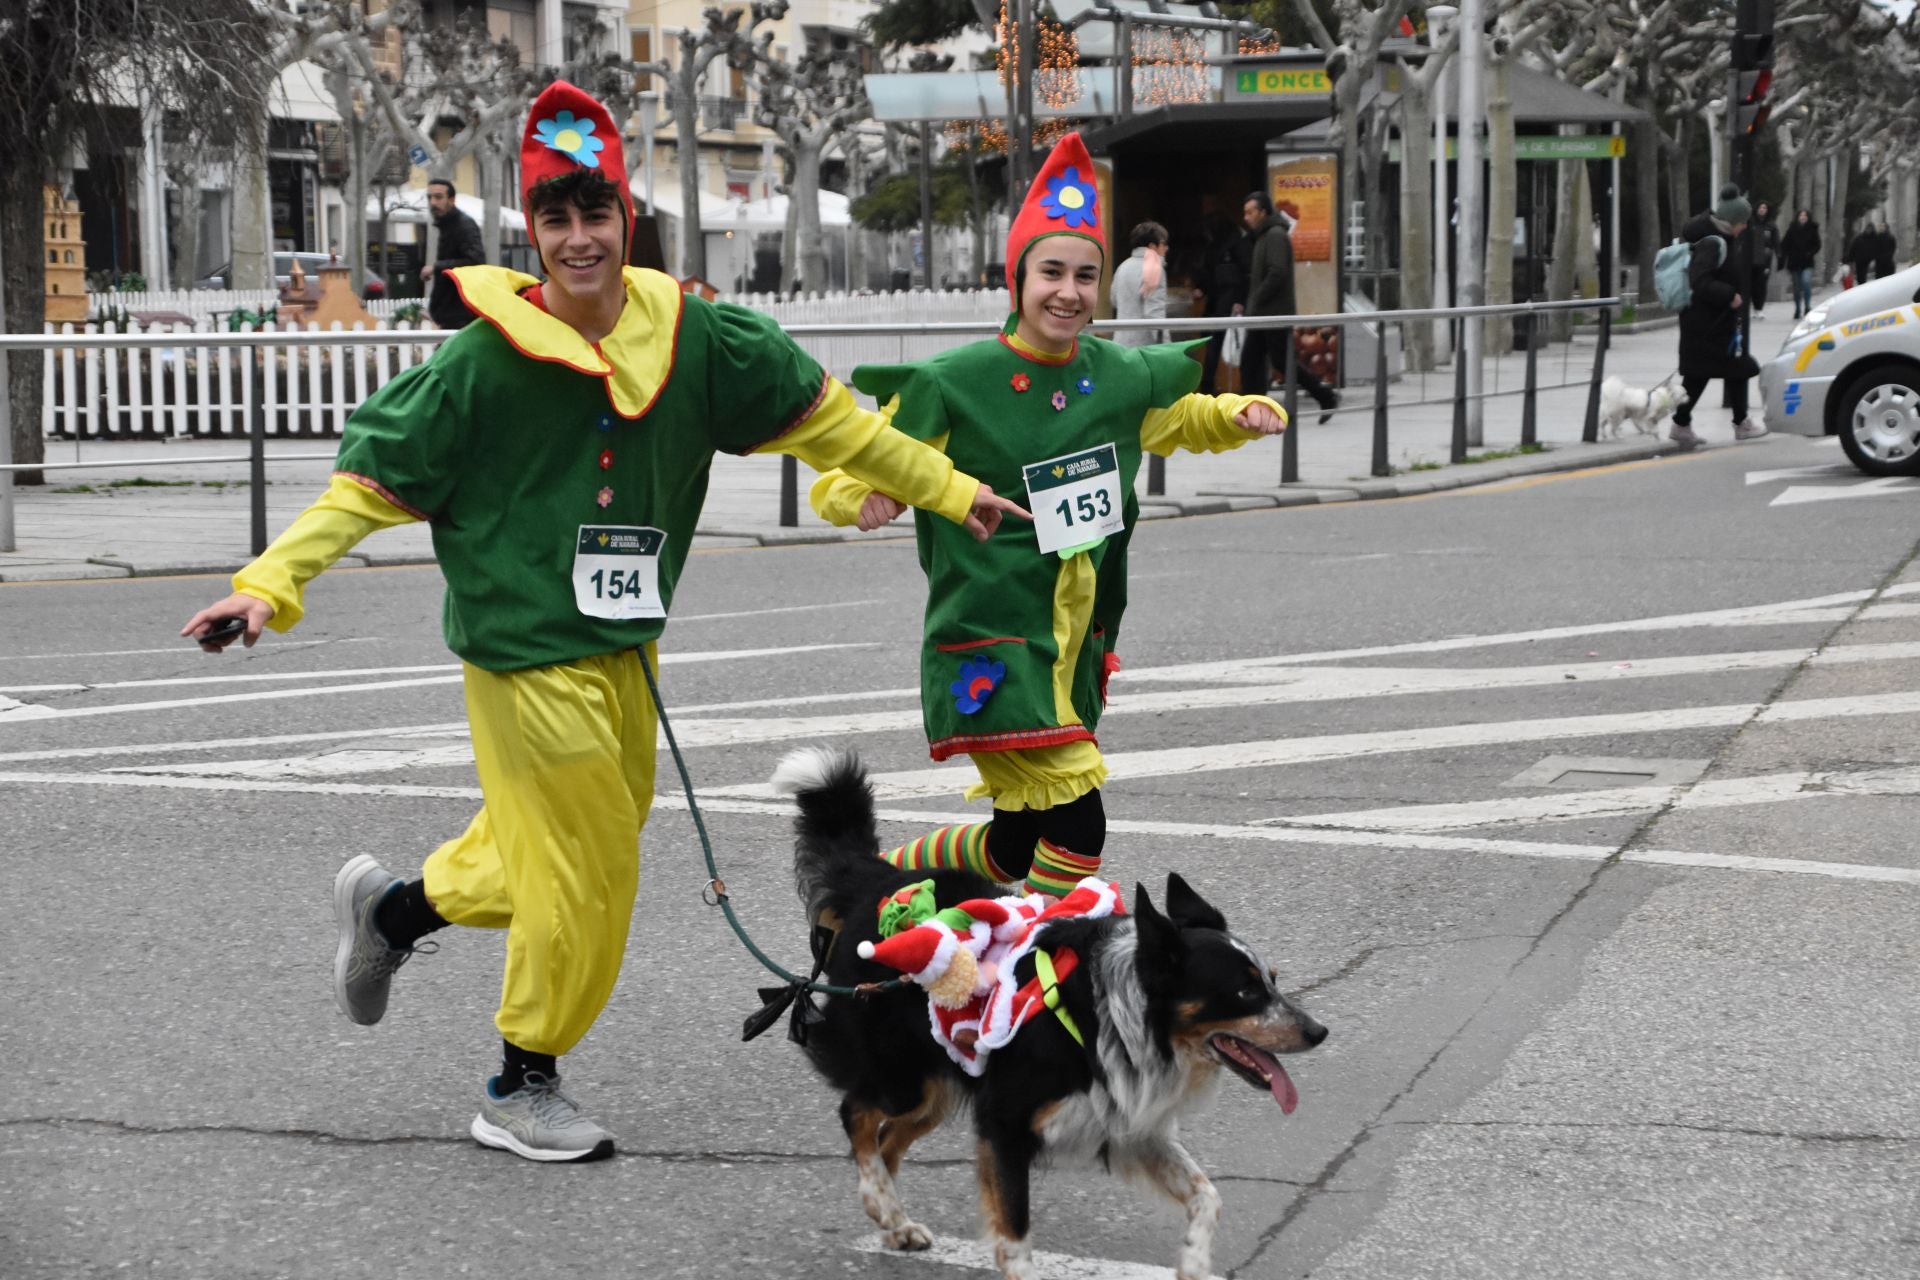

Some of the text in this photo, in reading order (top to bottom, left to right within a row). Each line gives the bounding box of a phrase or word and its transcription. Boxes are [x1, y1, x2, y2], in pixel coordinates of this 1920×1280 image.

[1265, 72, 1324, 89] ONCE
[1056, 488, 1111, 527] 153
[590, 569, 642, 600] 154
